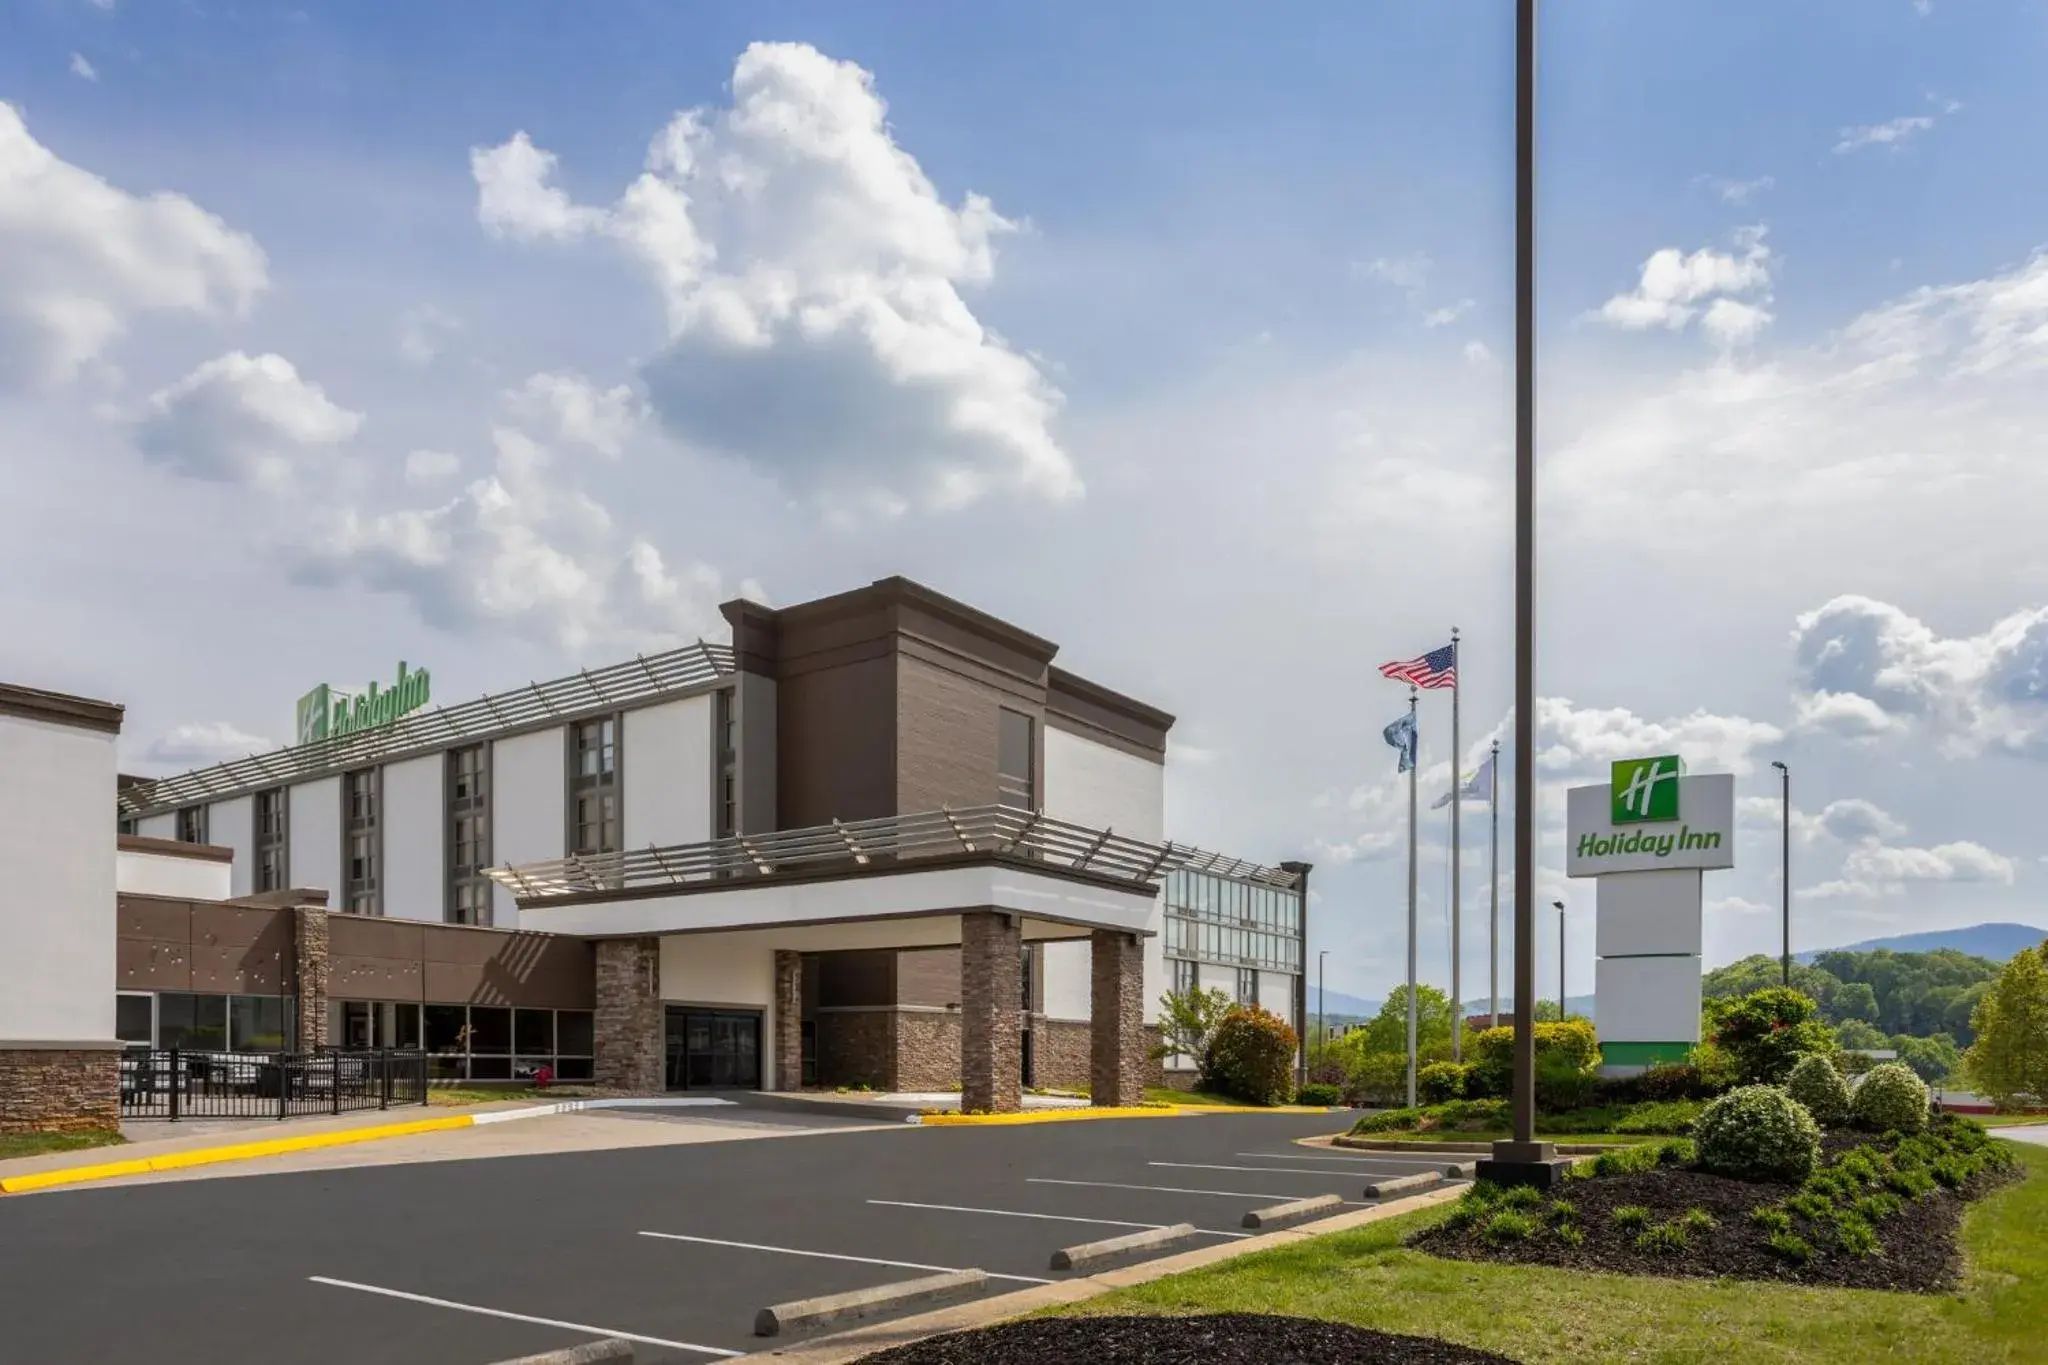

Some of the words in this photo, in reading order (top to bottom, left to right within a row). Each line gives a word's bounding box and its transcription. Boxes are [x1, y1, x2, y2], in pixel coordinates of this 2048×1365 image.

[1618, 761, 1677, 816] H
[1577, 829, 1675, 857] Holiday
[1678, 825, 1722, 850] Inn
